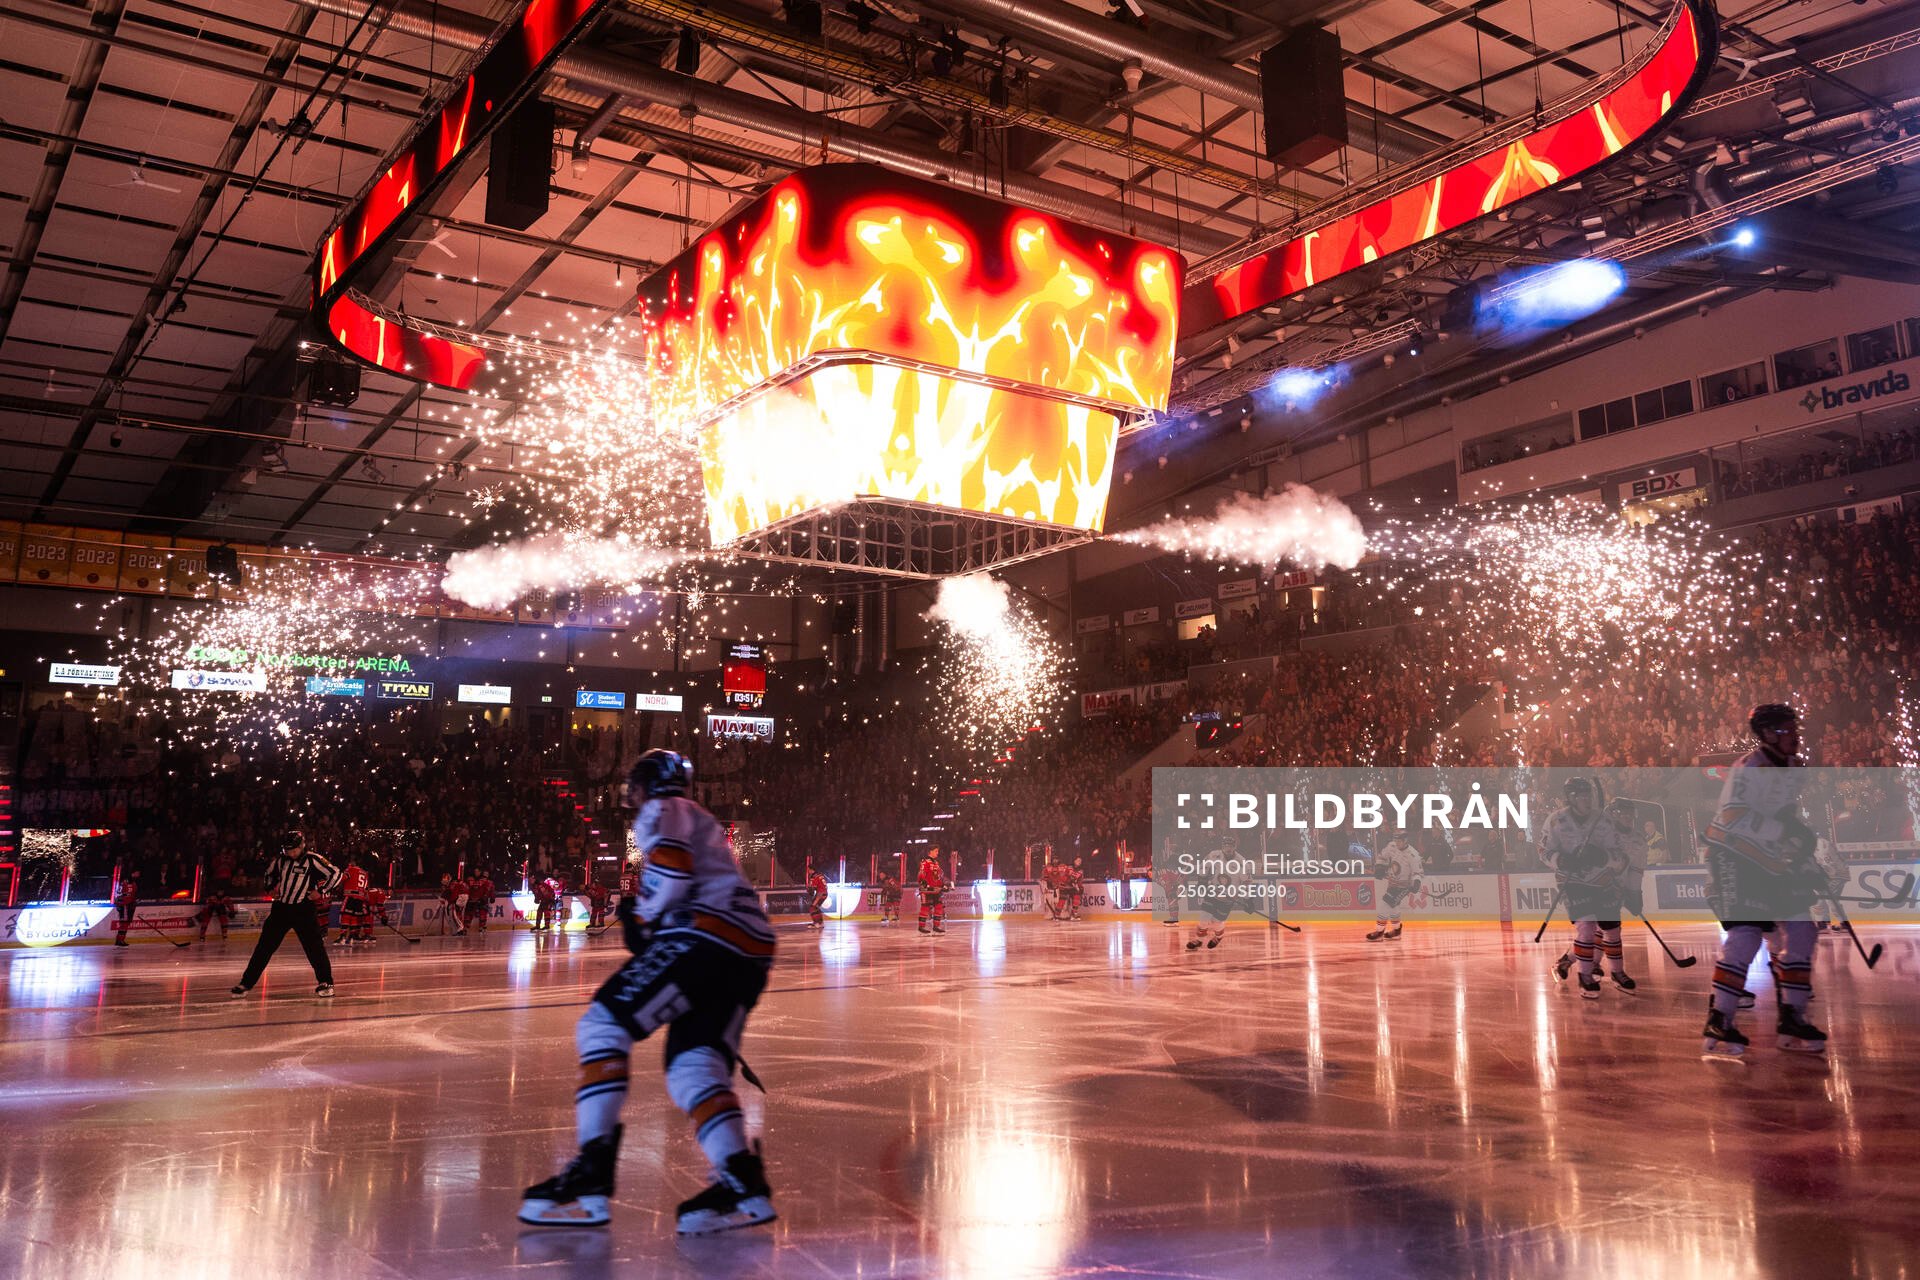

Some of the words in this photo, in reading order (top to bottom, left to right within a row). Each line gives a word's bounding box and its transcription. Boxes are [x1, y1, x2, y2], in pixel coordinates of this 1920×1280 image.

[1821, 370, 1910, 409] bravida
[1632, 473, 1681, 496] BDX
[26, 544, 66, 561] 2023
[76, 548, 115, 565] 2022
[1282, 572, 1307, 587] ABB
[256, 653, 347, 668] Norrbotten
[356, 657, 410, 672] ARENA
[382, 683, 430, 694] TITAN
[1085, 694, 1118, 710] MAXI
[712, 719, 754, 733] MAXI
[619, 879, 630, 890] 96
[1432, 880, 1464, 893] Luleå
[1015, 888, 1033, 901] FÖR
[1303, 884, 1351, 907] Dumle
[988, 903, 1034, 912] NORRBOTTEN
[1433, 896, 1473, 909] Energi
